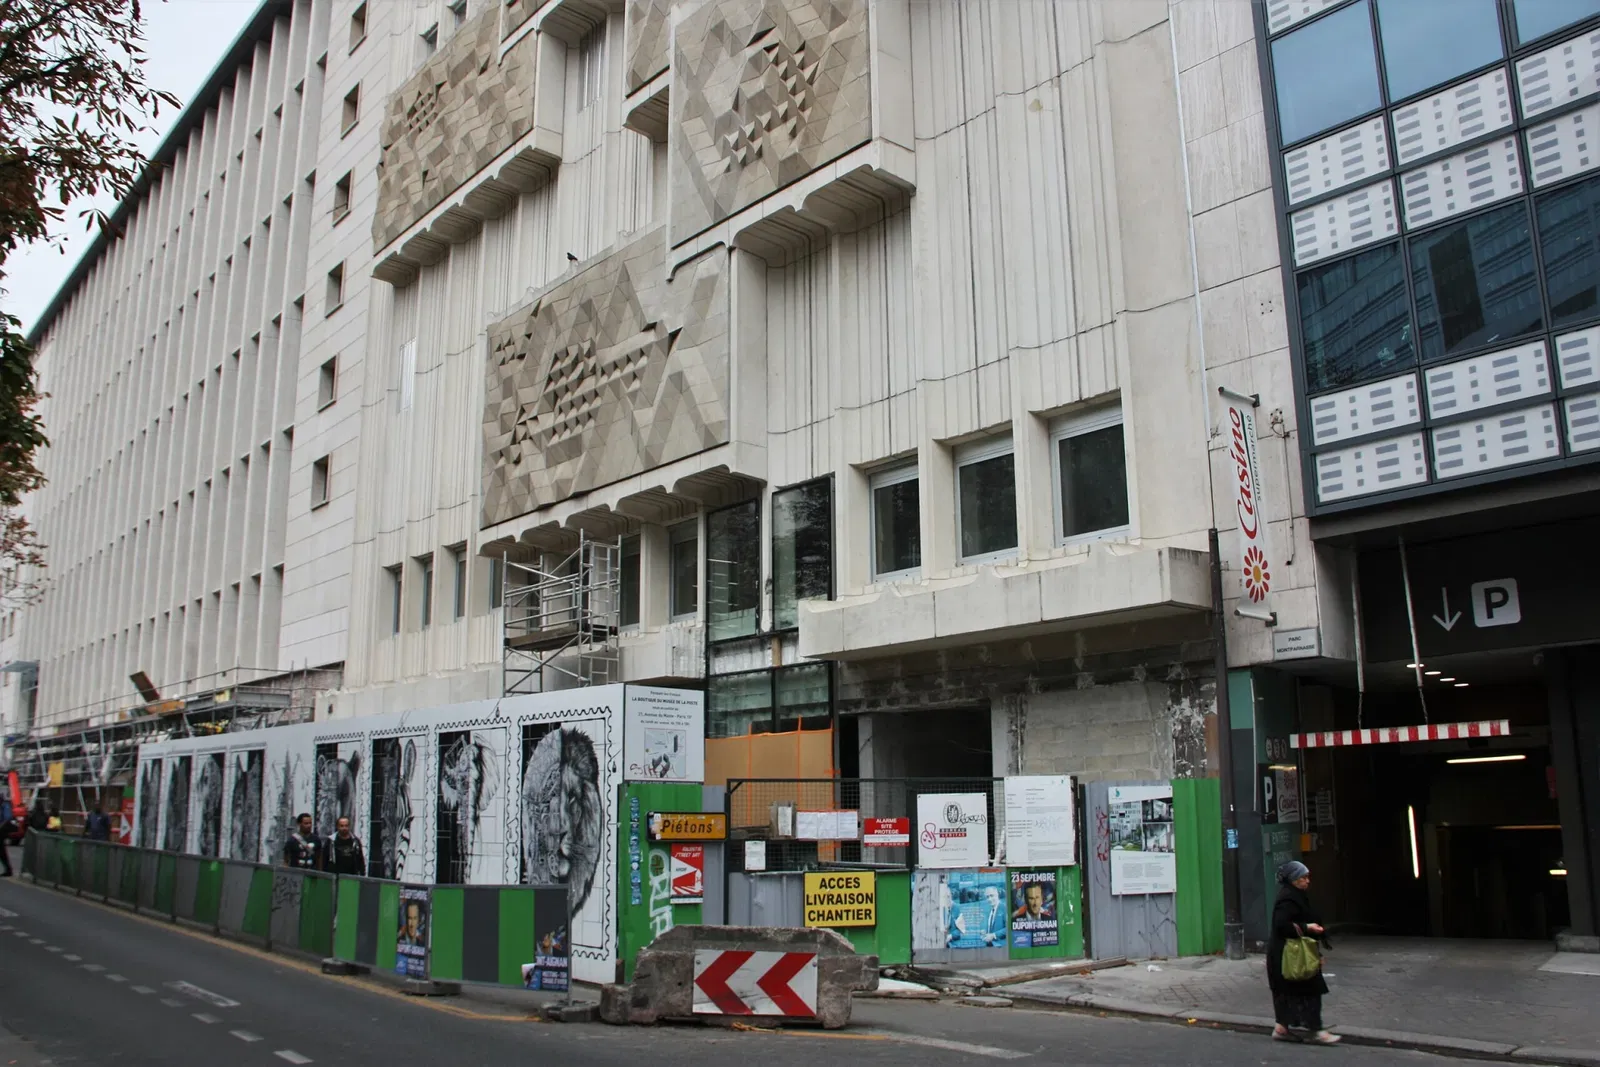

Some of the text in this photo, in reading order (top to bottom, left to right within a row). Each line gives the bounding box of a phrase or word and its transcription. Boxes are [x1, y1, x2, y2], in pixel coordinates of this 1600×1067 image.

[1228, 406, 1258, 540] Casino
[1483, 587, 1509, 619] P
[1276, 644, 1315, 653] MONTPARNASSE
[1263, 776, 1274, 814] P
[661, 819, 713, 834] Piétons
[819, 876, 861, 889] ACCES
[1011, 872, 1056, 883] 23 SEPTEMBRE
[806, 892, 874, 906] LIVRAISON
[808, 908, 872, 922] CHANTIER
